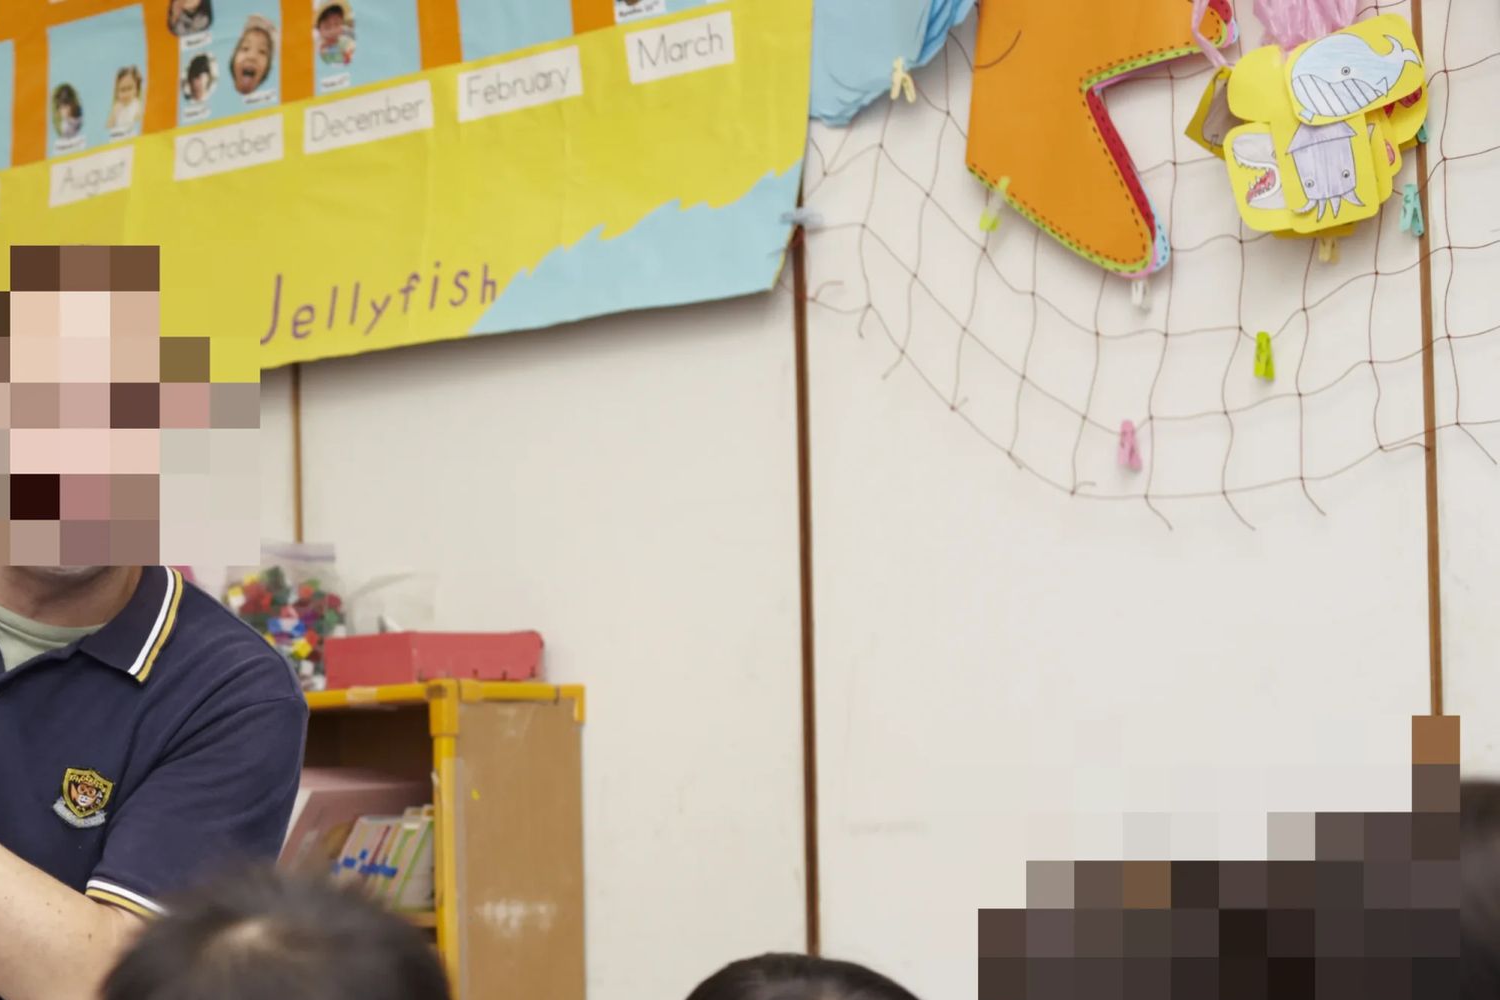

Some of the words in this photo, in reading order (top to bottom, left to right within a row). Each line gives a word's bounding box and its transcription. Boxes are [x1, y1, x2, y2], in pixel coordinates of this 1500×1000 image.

[636, 23, 725, 69] March
[465, 63, 572, 108] February
[309, 96, 426, 144] December
[182, 128, 277, 168] October
[58, 159, 126, 198] August
[260, 260, 499, 346] Jellyfish
